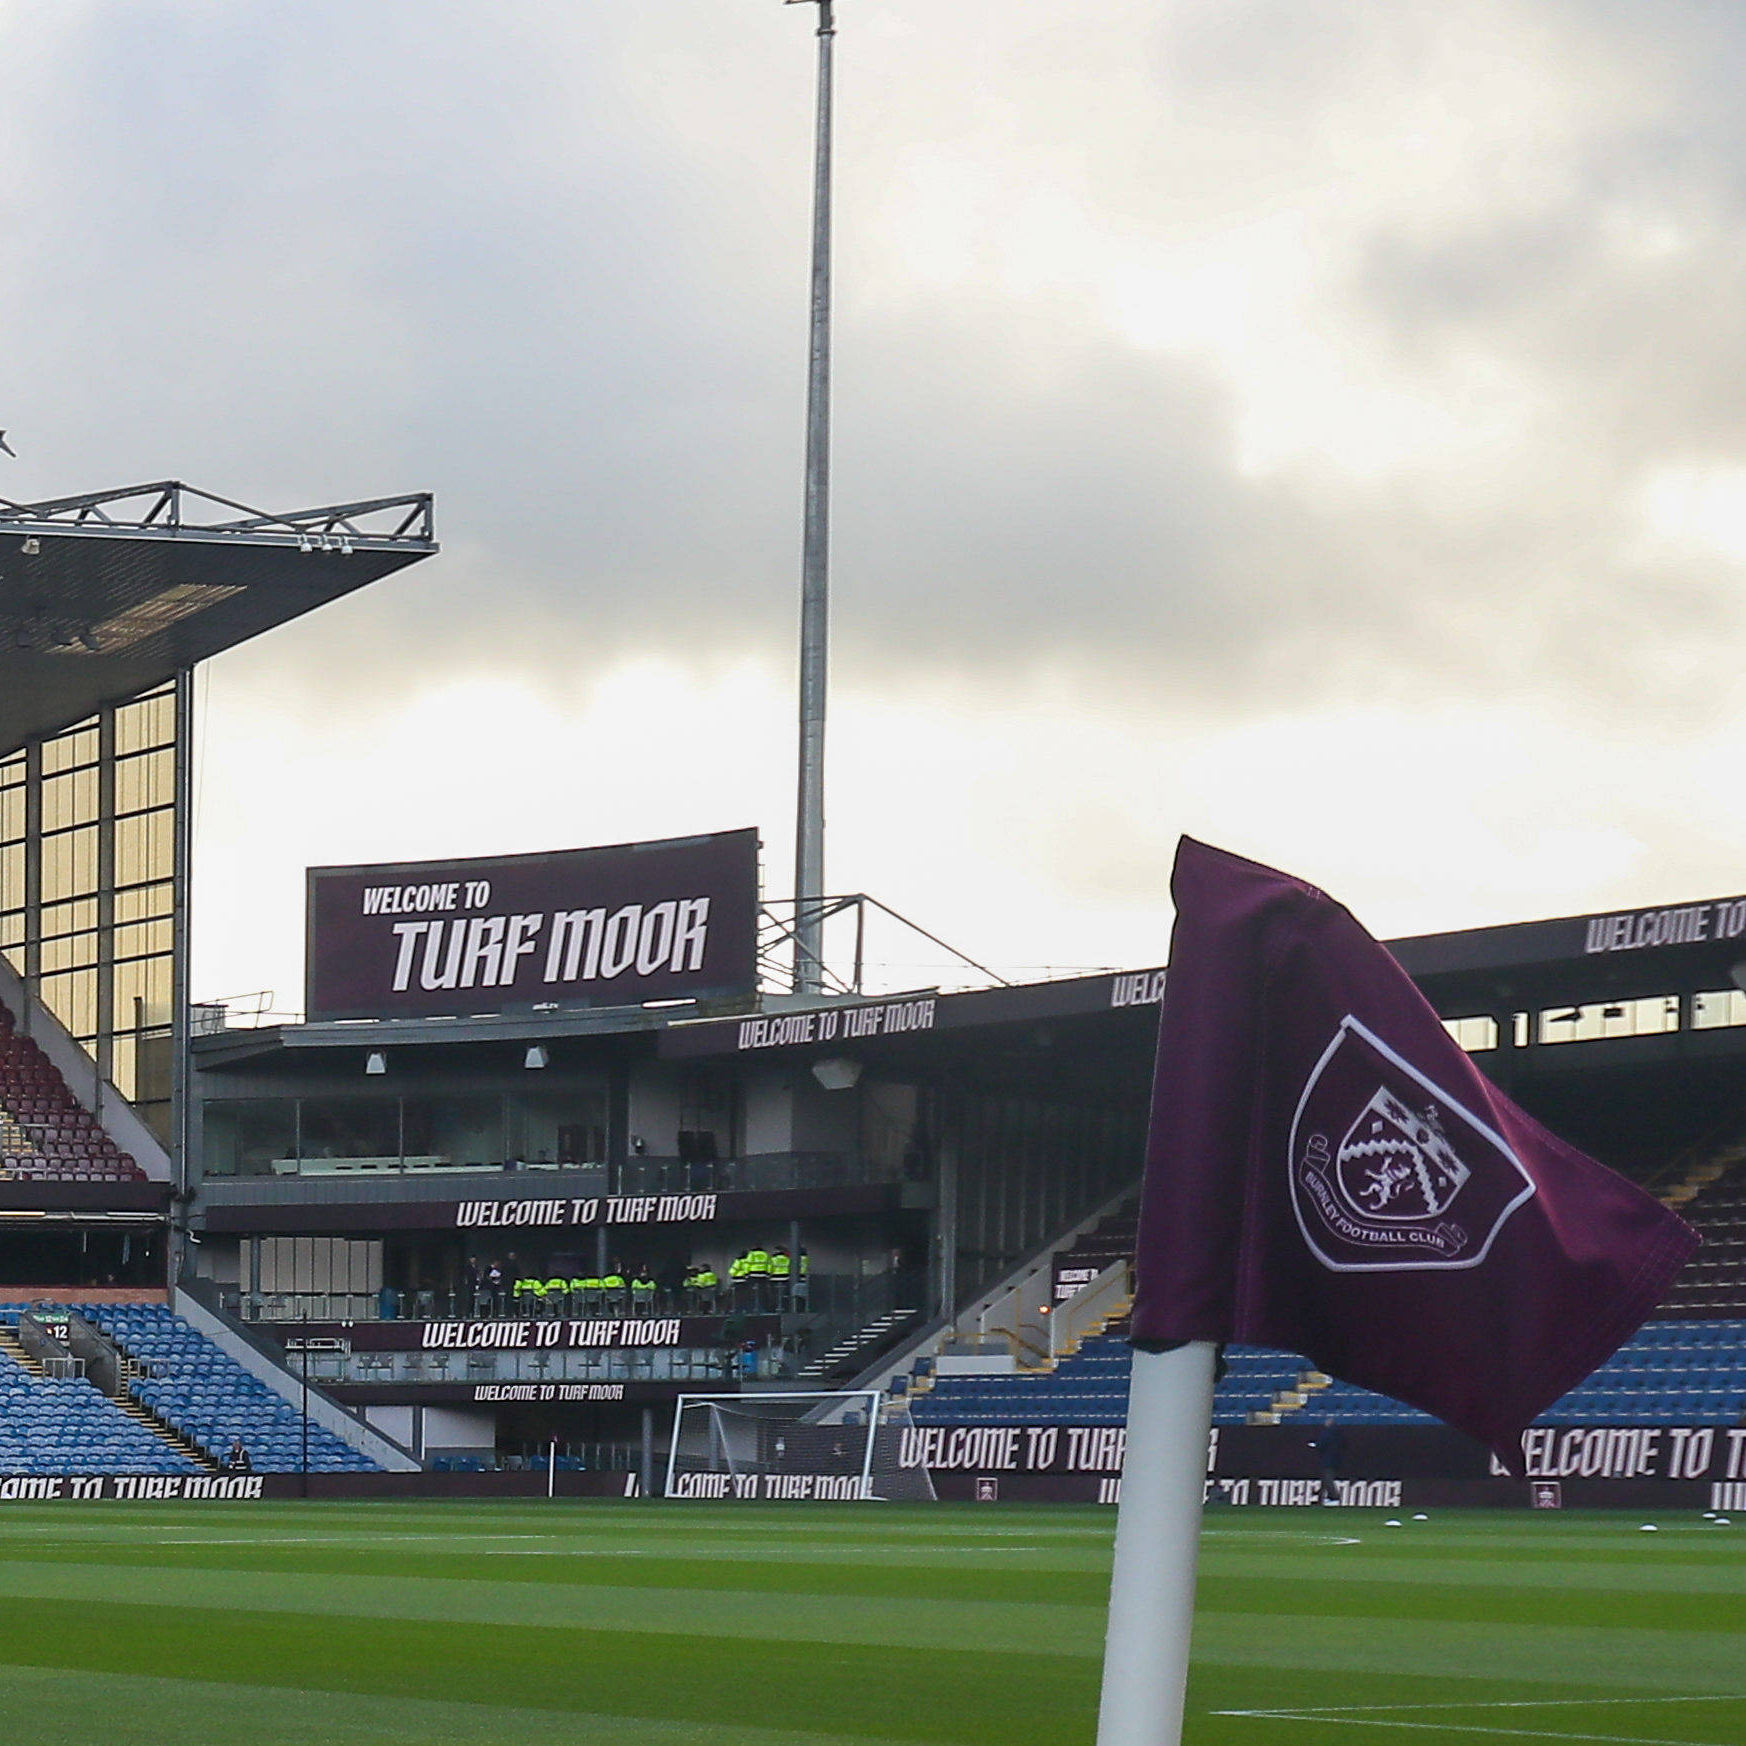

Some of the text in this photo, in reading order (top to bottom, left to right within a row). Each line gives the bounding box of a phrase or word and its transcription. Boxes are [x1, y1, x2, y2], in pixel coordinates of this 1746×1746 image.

[363, 880, 491, 915] WELCOME TO
[1586, 900, 1746, 953] WELCOME TO
[392, 898, 710, 991] TURF MOOR
[738, 999, 935, 1050] WELCOME TO TURF MOOR
[457, 1194, 718, 1227] WELCOME TO TURF MOOR
[1304, 1171, 1446, 1249] BURNLEY FOOTBALL CLUB
[53, 1325, 68, 1339] 12
[422, 1319, 680, 1348] WELCOME TO TURF MOOR
[474, 1384, 624, 1401] WELCOME TO TURF MOOR
[899, 1427, 1021, 1469] WELCOME
[1026, 1427, 1059, 1470] TO
[1668, 1428, 1714, 1479] TO
[70, 1477, 103, 1499] TO
[114, 1477, 181, 1499] TURF
[182, 1476, 264, 1498] MOOR
[765, 1474, 813, 1499] TURF
[1258, 1479, 1322, 1506] TURF
